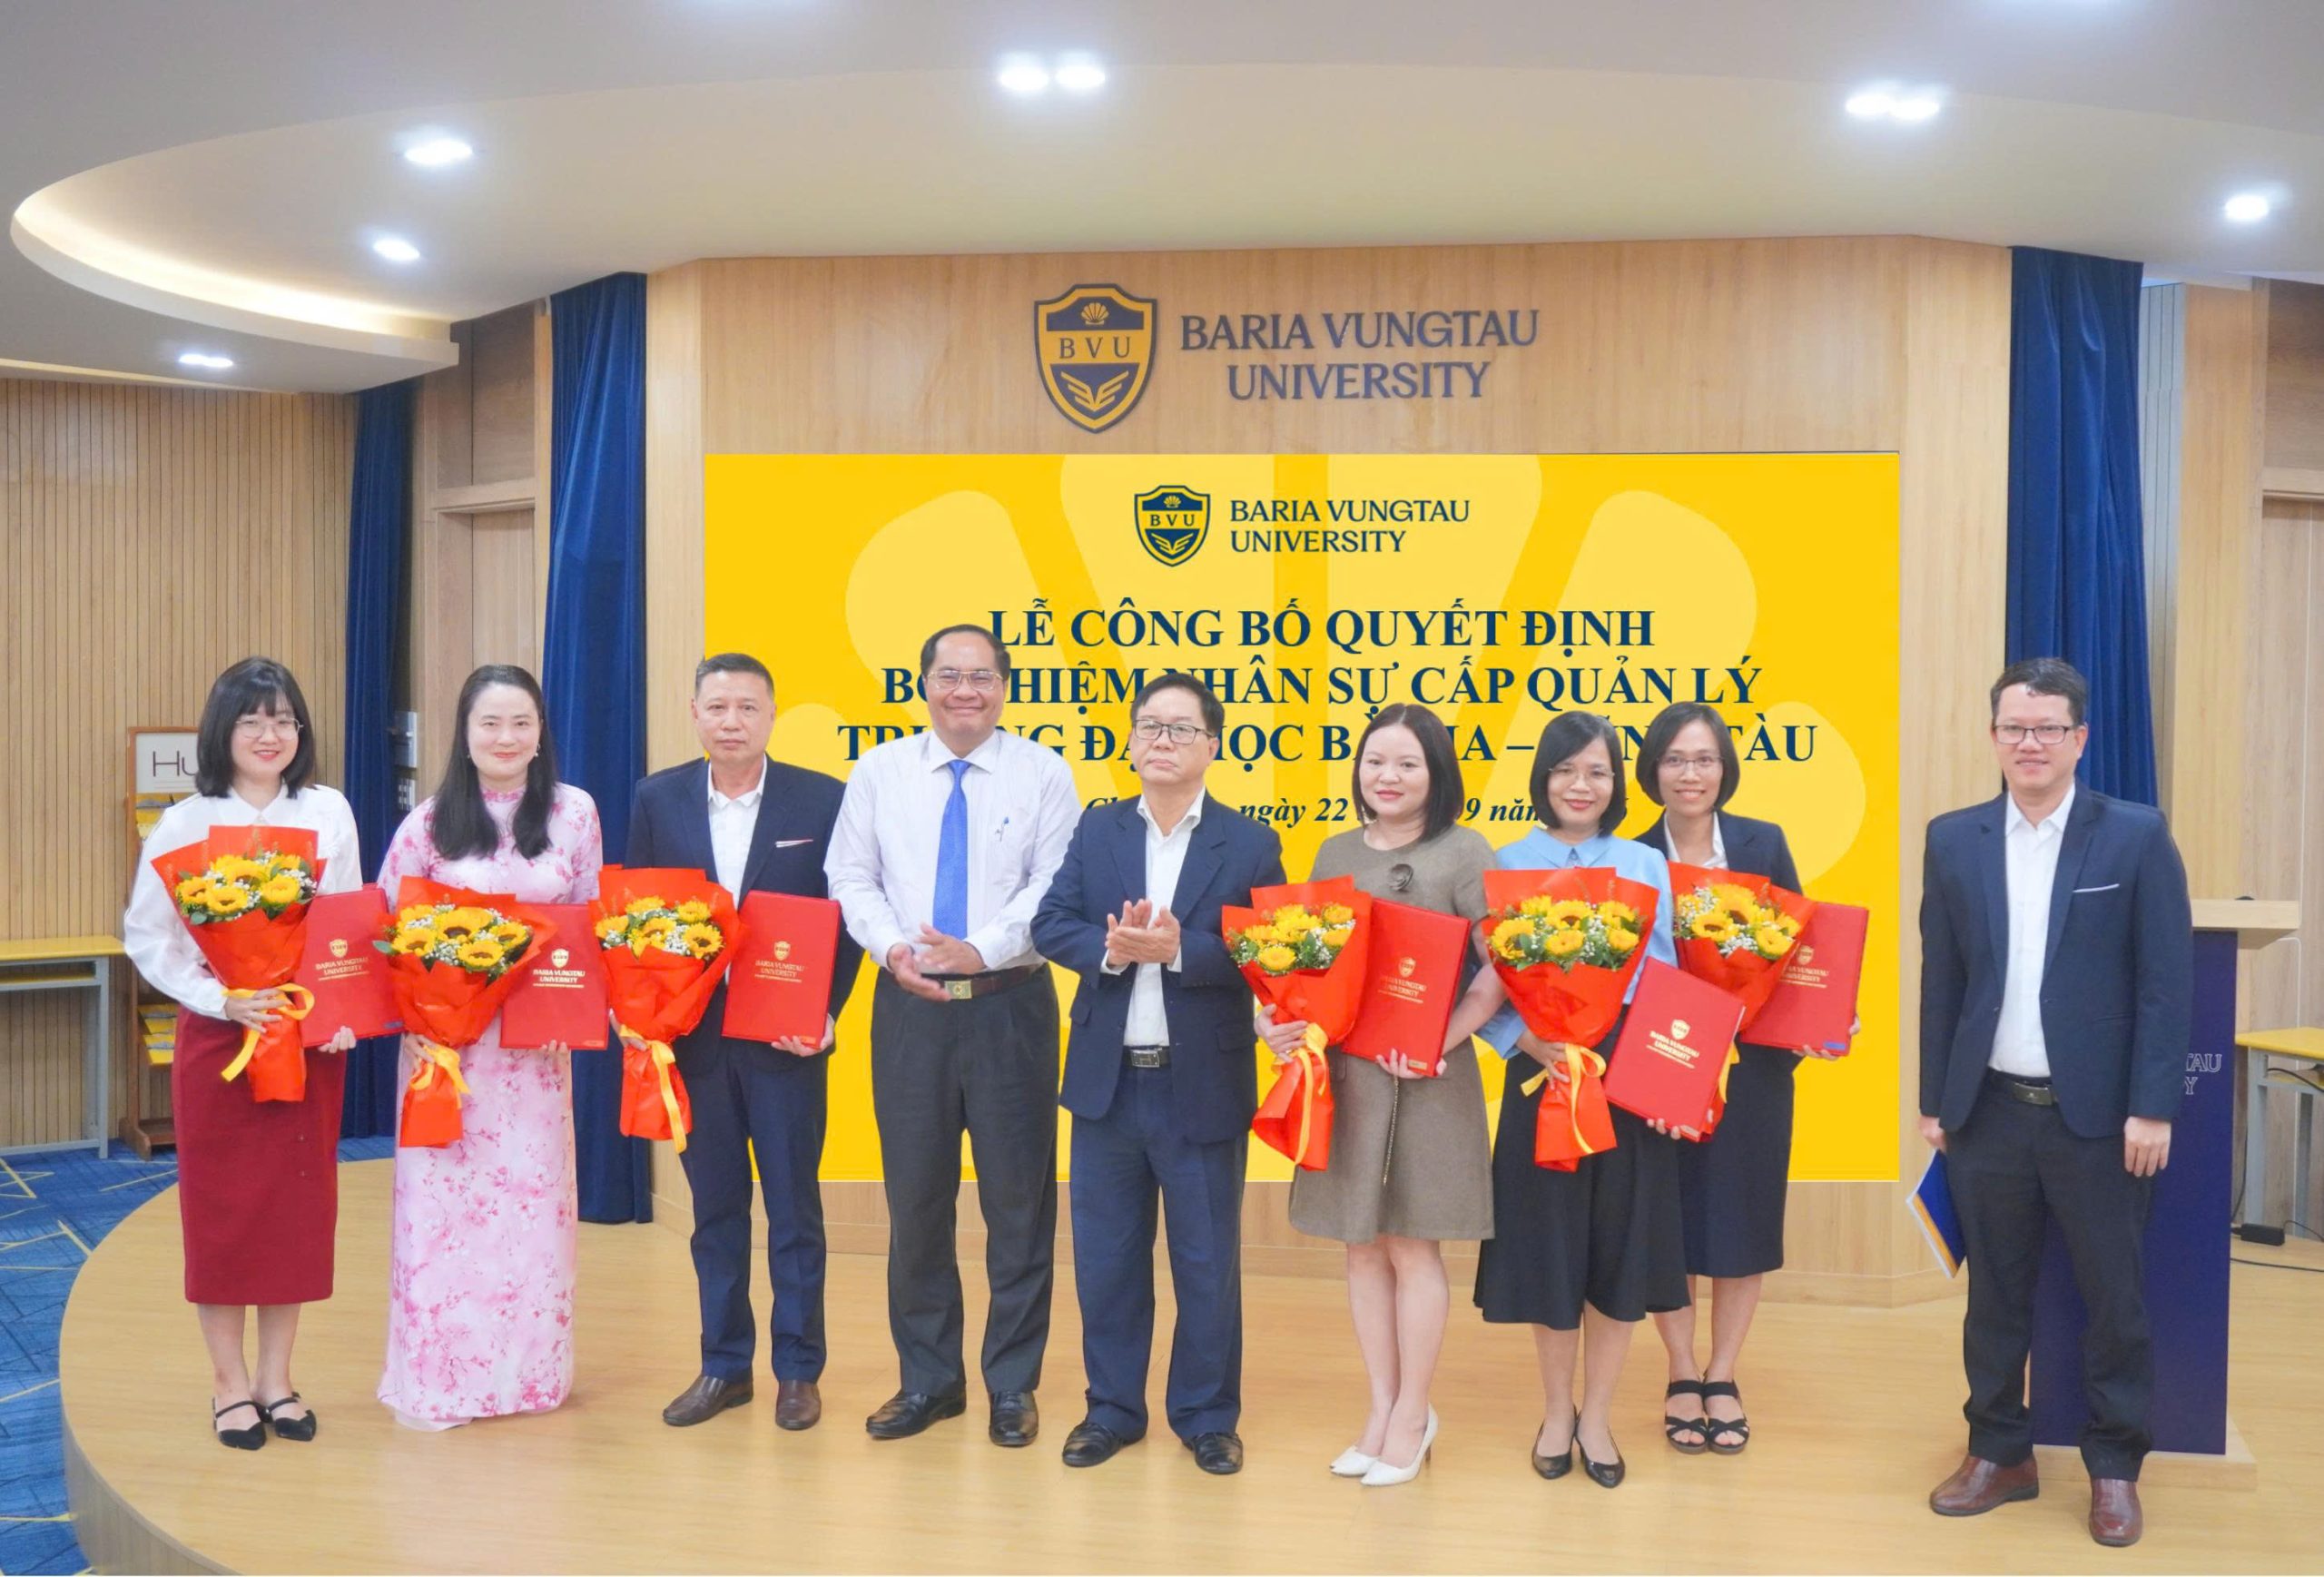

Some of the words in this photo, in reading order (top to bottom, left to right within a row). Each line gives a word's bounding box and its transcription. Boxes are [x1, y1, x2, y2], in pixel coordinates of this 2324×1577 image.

[1181, 313, 1315, 350] BARIA
[1323, 310, 1540, 349] VUNGTAU
[1059, 337, 1131, 360] BVU
[1227, 361, 1492, 400] UNIVERSITY
[1150, 513, 1196, 527] BVU
[1230, 499, 1321, 522] BARIA
[1325, 499, 1470, 522] VUNGTAU
[1231, 530, 1406, 553] UNIVERSITY
[988, 597, 1055, 646] LỄ
[1070, 596, 1224, 647] CÔNG
[1238, 597, 1311, 647] BỐ
[1325, 597, 1508, 655] QUYẾT
[1521, 610, 1655, 658] ĐỊNH
[881, 667, 927, 704] B
[1006, 660, 1149, 715] HIỆM
[1161, 654, 1313, 705] HÂN
[1328, 661, 1399, 715] SỰ
[1411, 655, 1515, 705] CẤP
[1527, 655, 1677, 712] QUẢN
[1691, 655, 1763, 705] LÝ
[1314, 797, 1349, 822] 22
